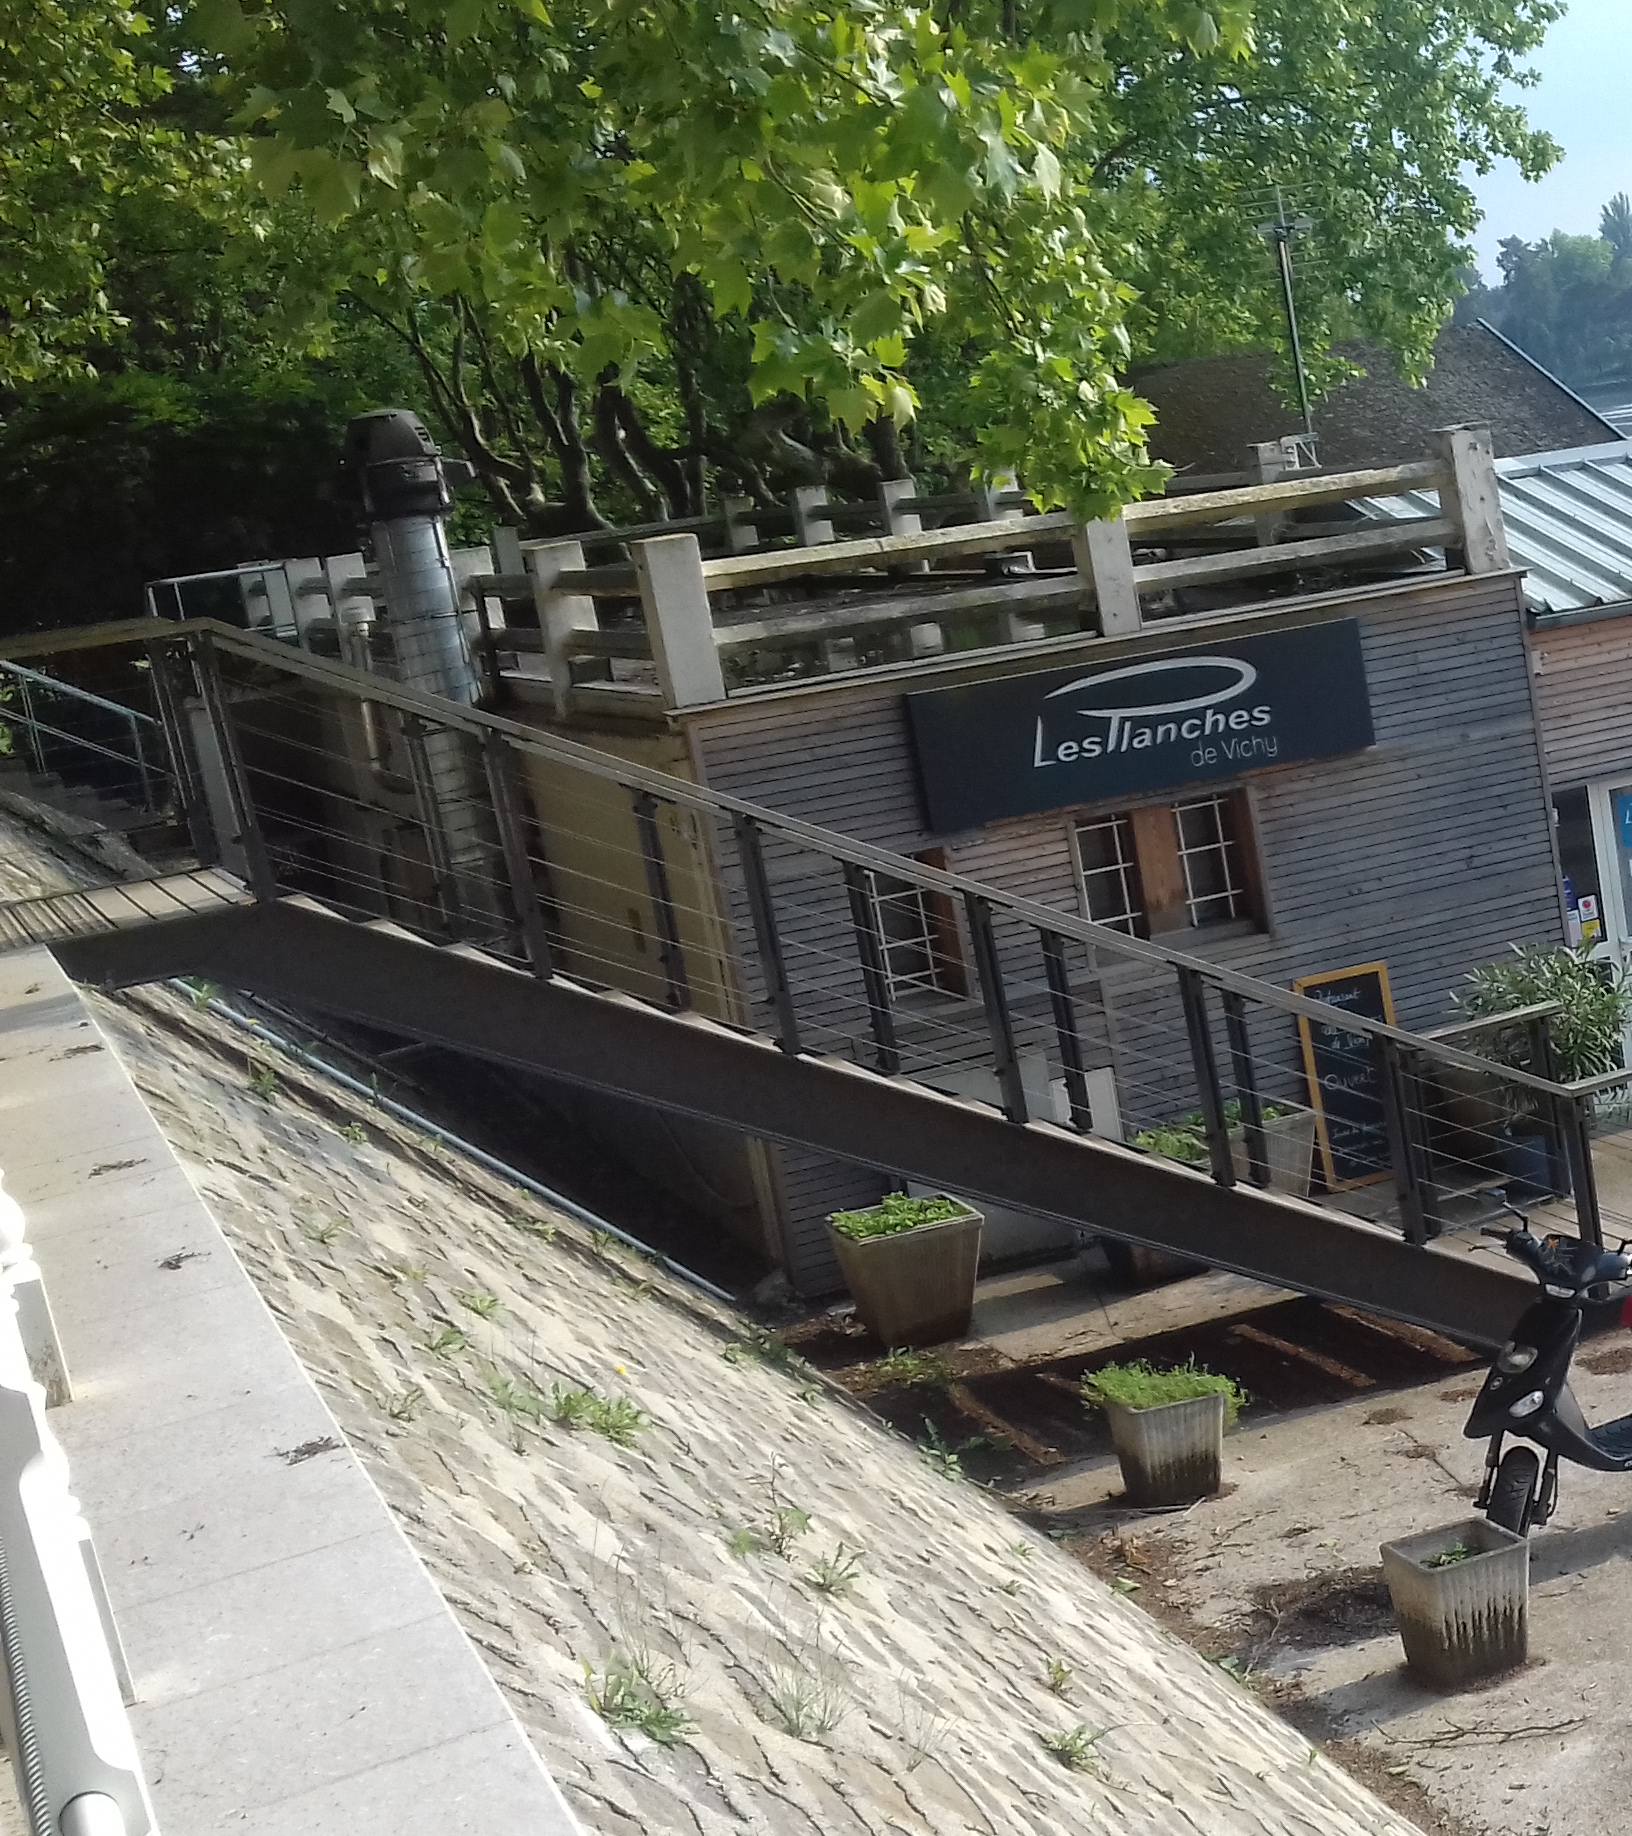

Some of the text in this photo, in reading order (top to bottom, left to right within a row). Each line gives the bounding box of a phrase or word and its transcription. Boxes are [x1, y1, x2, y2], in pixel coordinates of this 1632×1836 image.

[1033, 715, 1103, 768] Les
[1190, 735, 1279, 767] de Vichy
